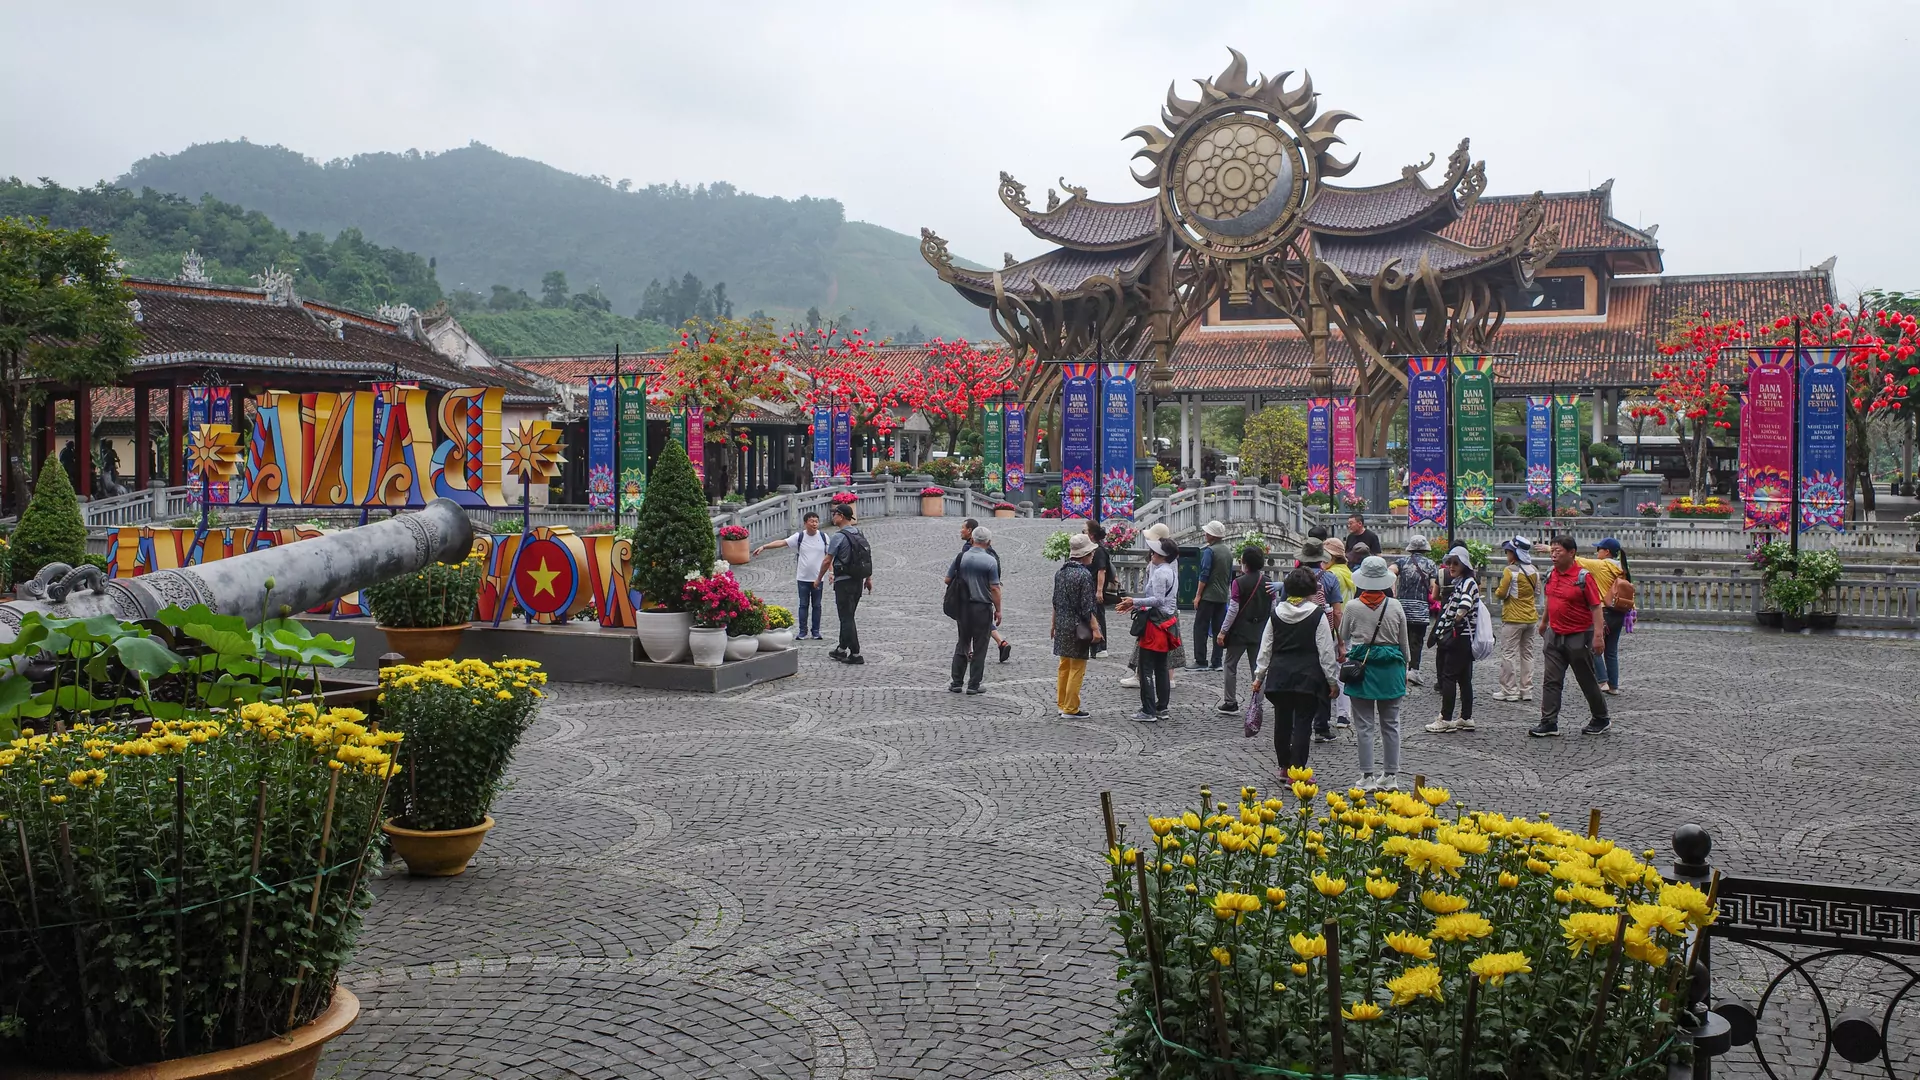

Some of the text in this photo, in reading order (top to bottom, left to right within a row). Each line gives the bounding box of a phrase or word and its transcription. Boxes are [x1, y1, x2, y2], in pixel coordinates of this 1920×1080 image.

[1760, 384, 1781, 393] BANA
[1812, 384, 1834, 392] BANA
[1418, 390, 1437, 398] BANA
[1463, 390, 1483, 398] BANA
